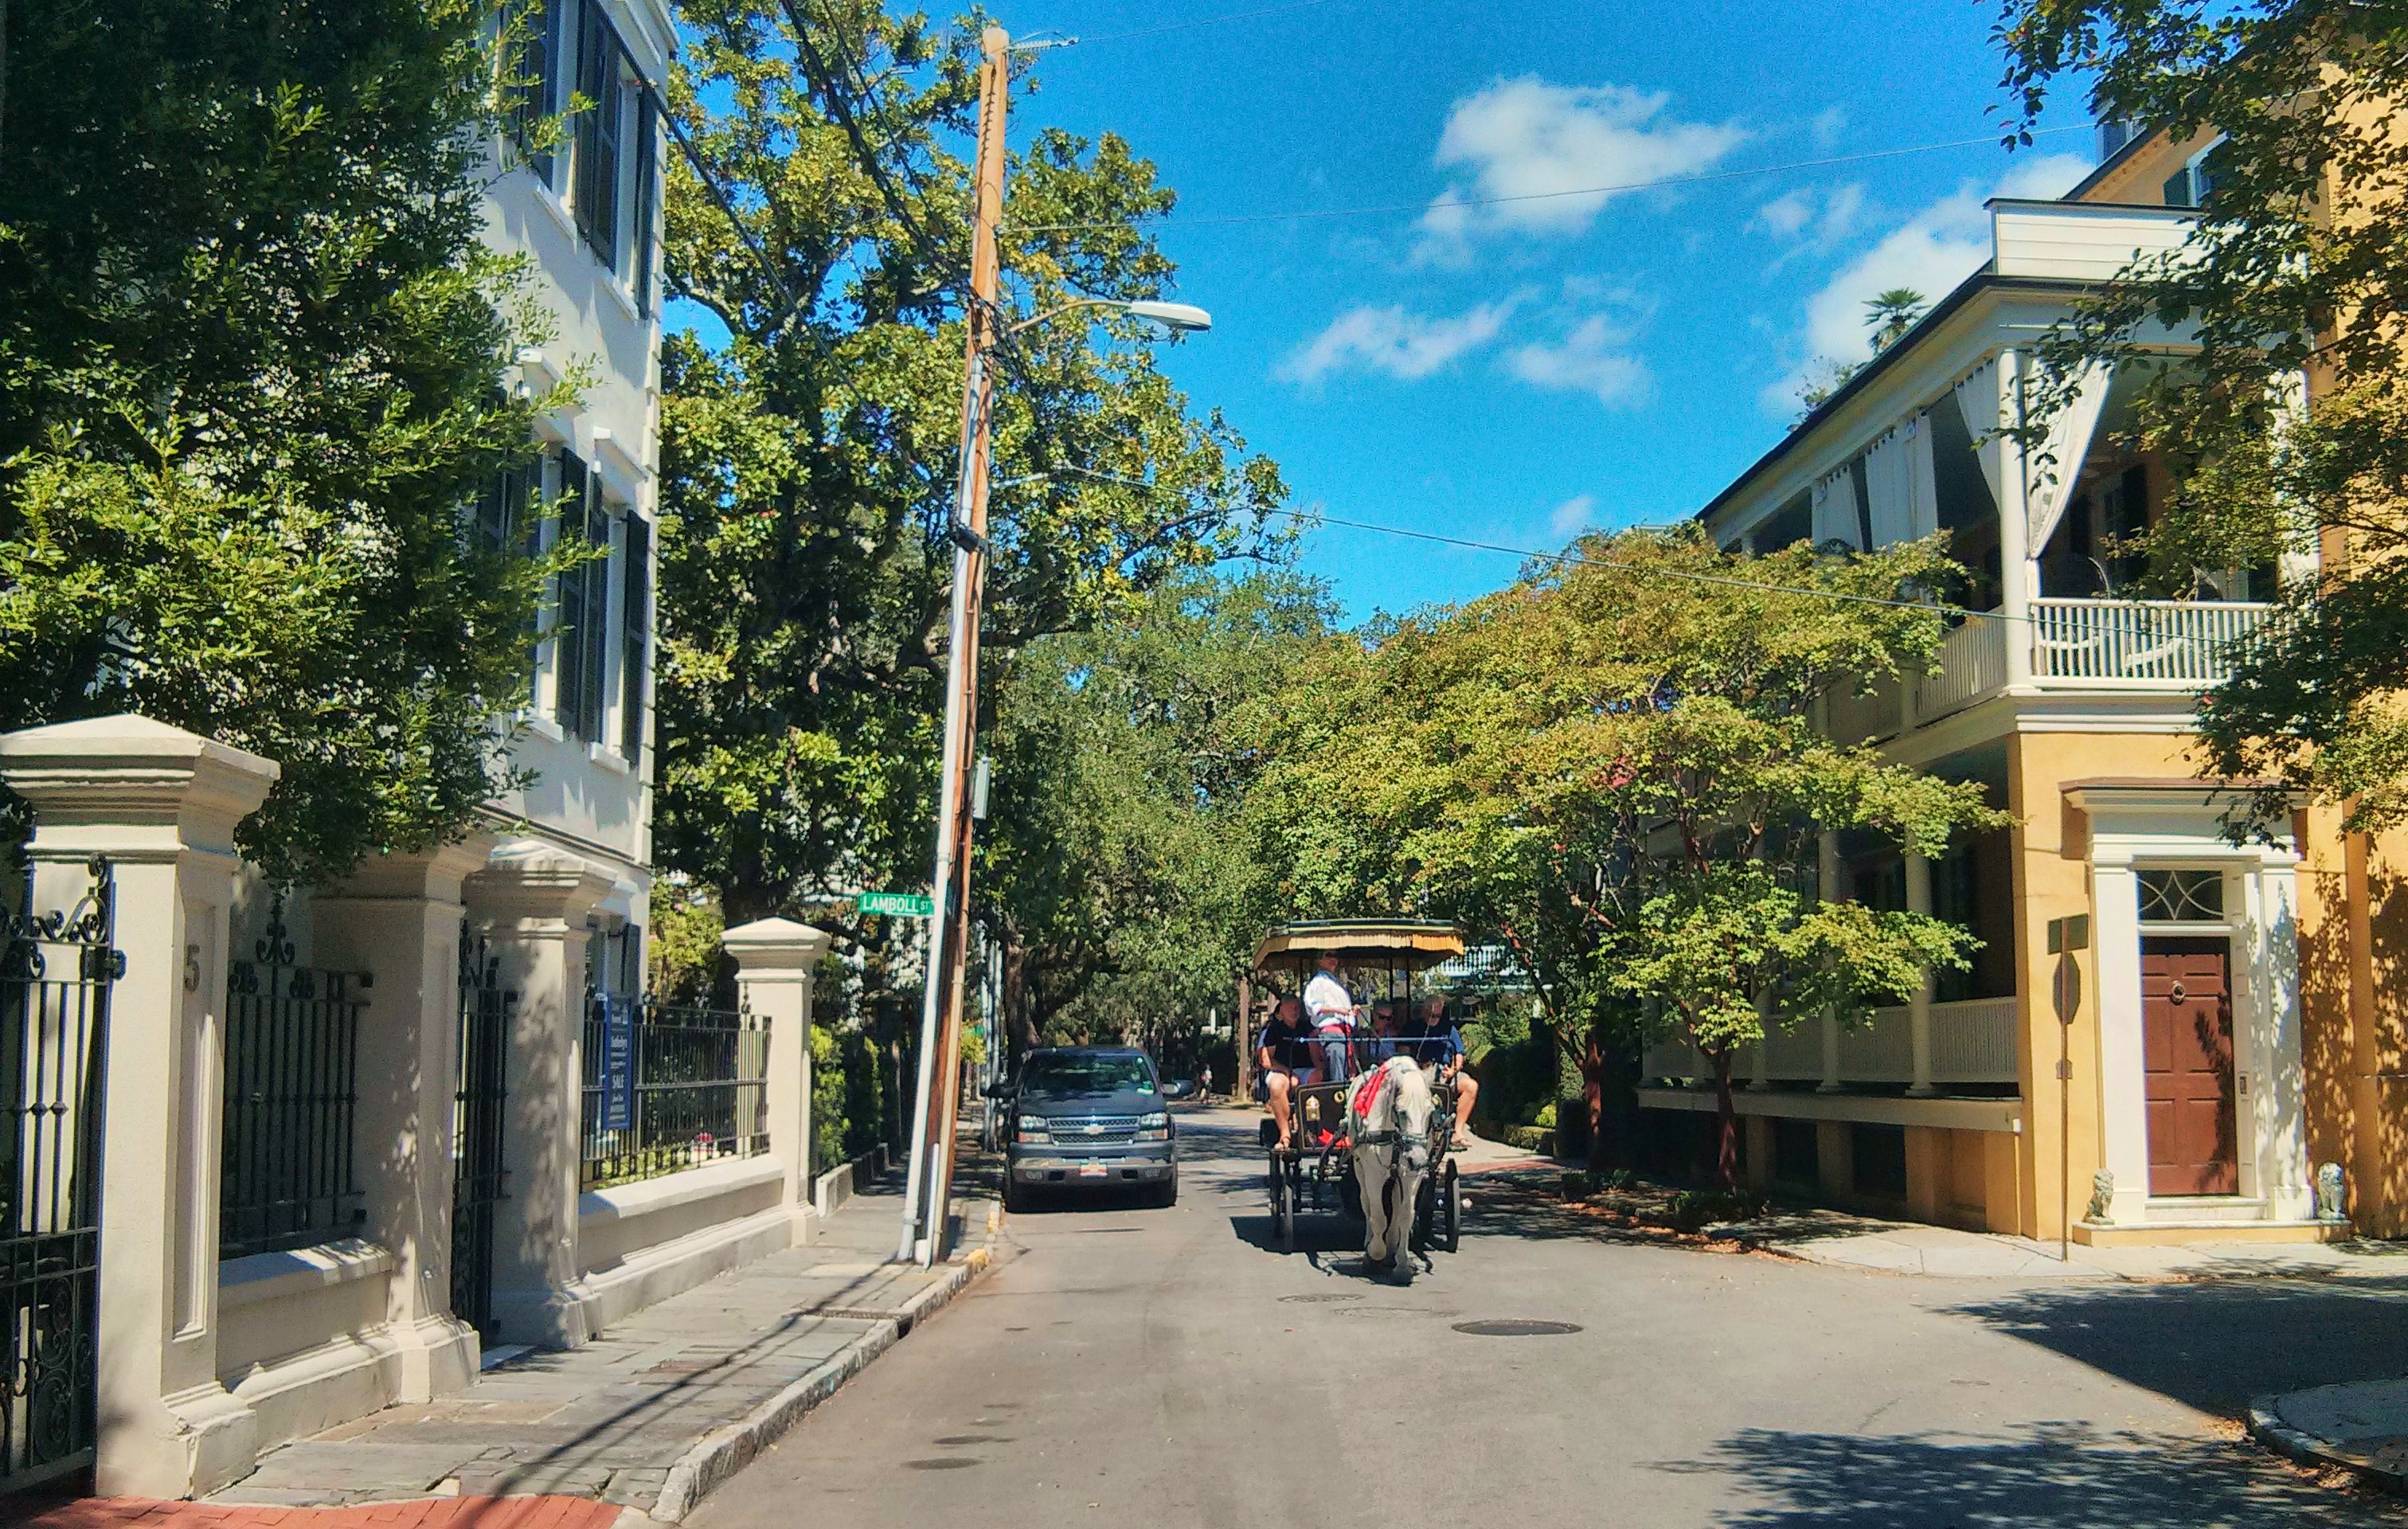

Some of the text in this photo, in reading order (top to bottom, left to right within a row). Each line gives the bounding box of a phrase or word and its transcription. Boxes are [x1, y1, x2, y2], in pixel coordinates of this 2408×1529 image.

[862, 895, 930, 913] LAMBOLL ST
[184, 944, 201, 993] 5
[612, 1074, 624, 1089] SALE
